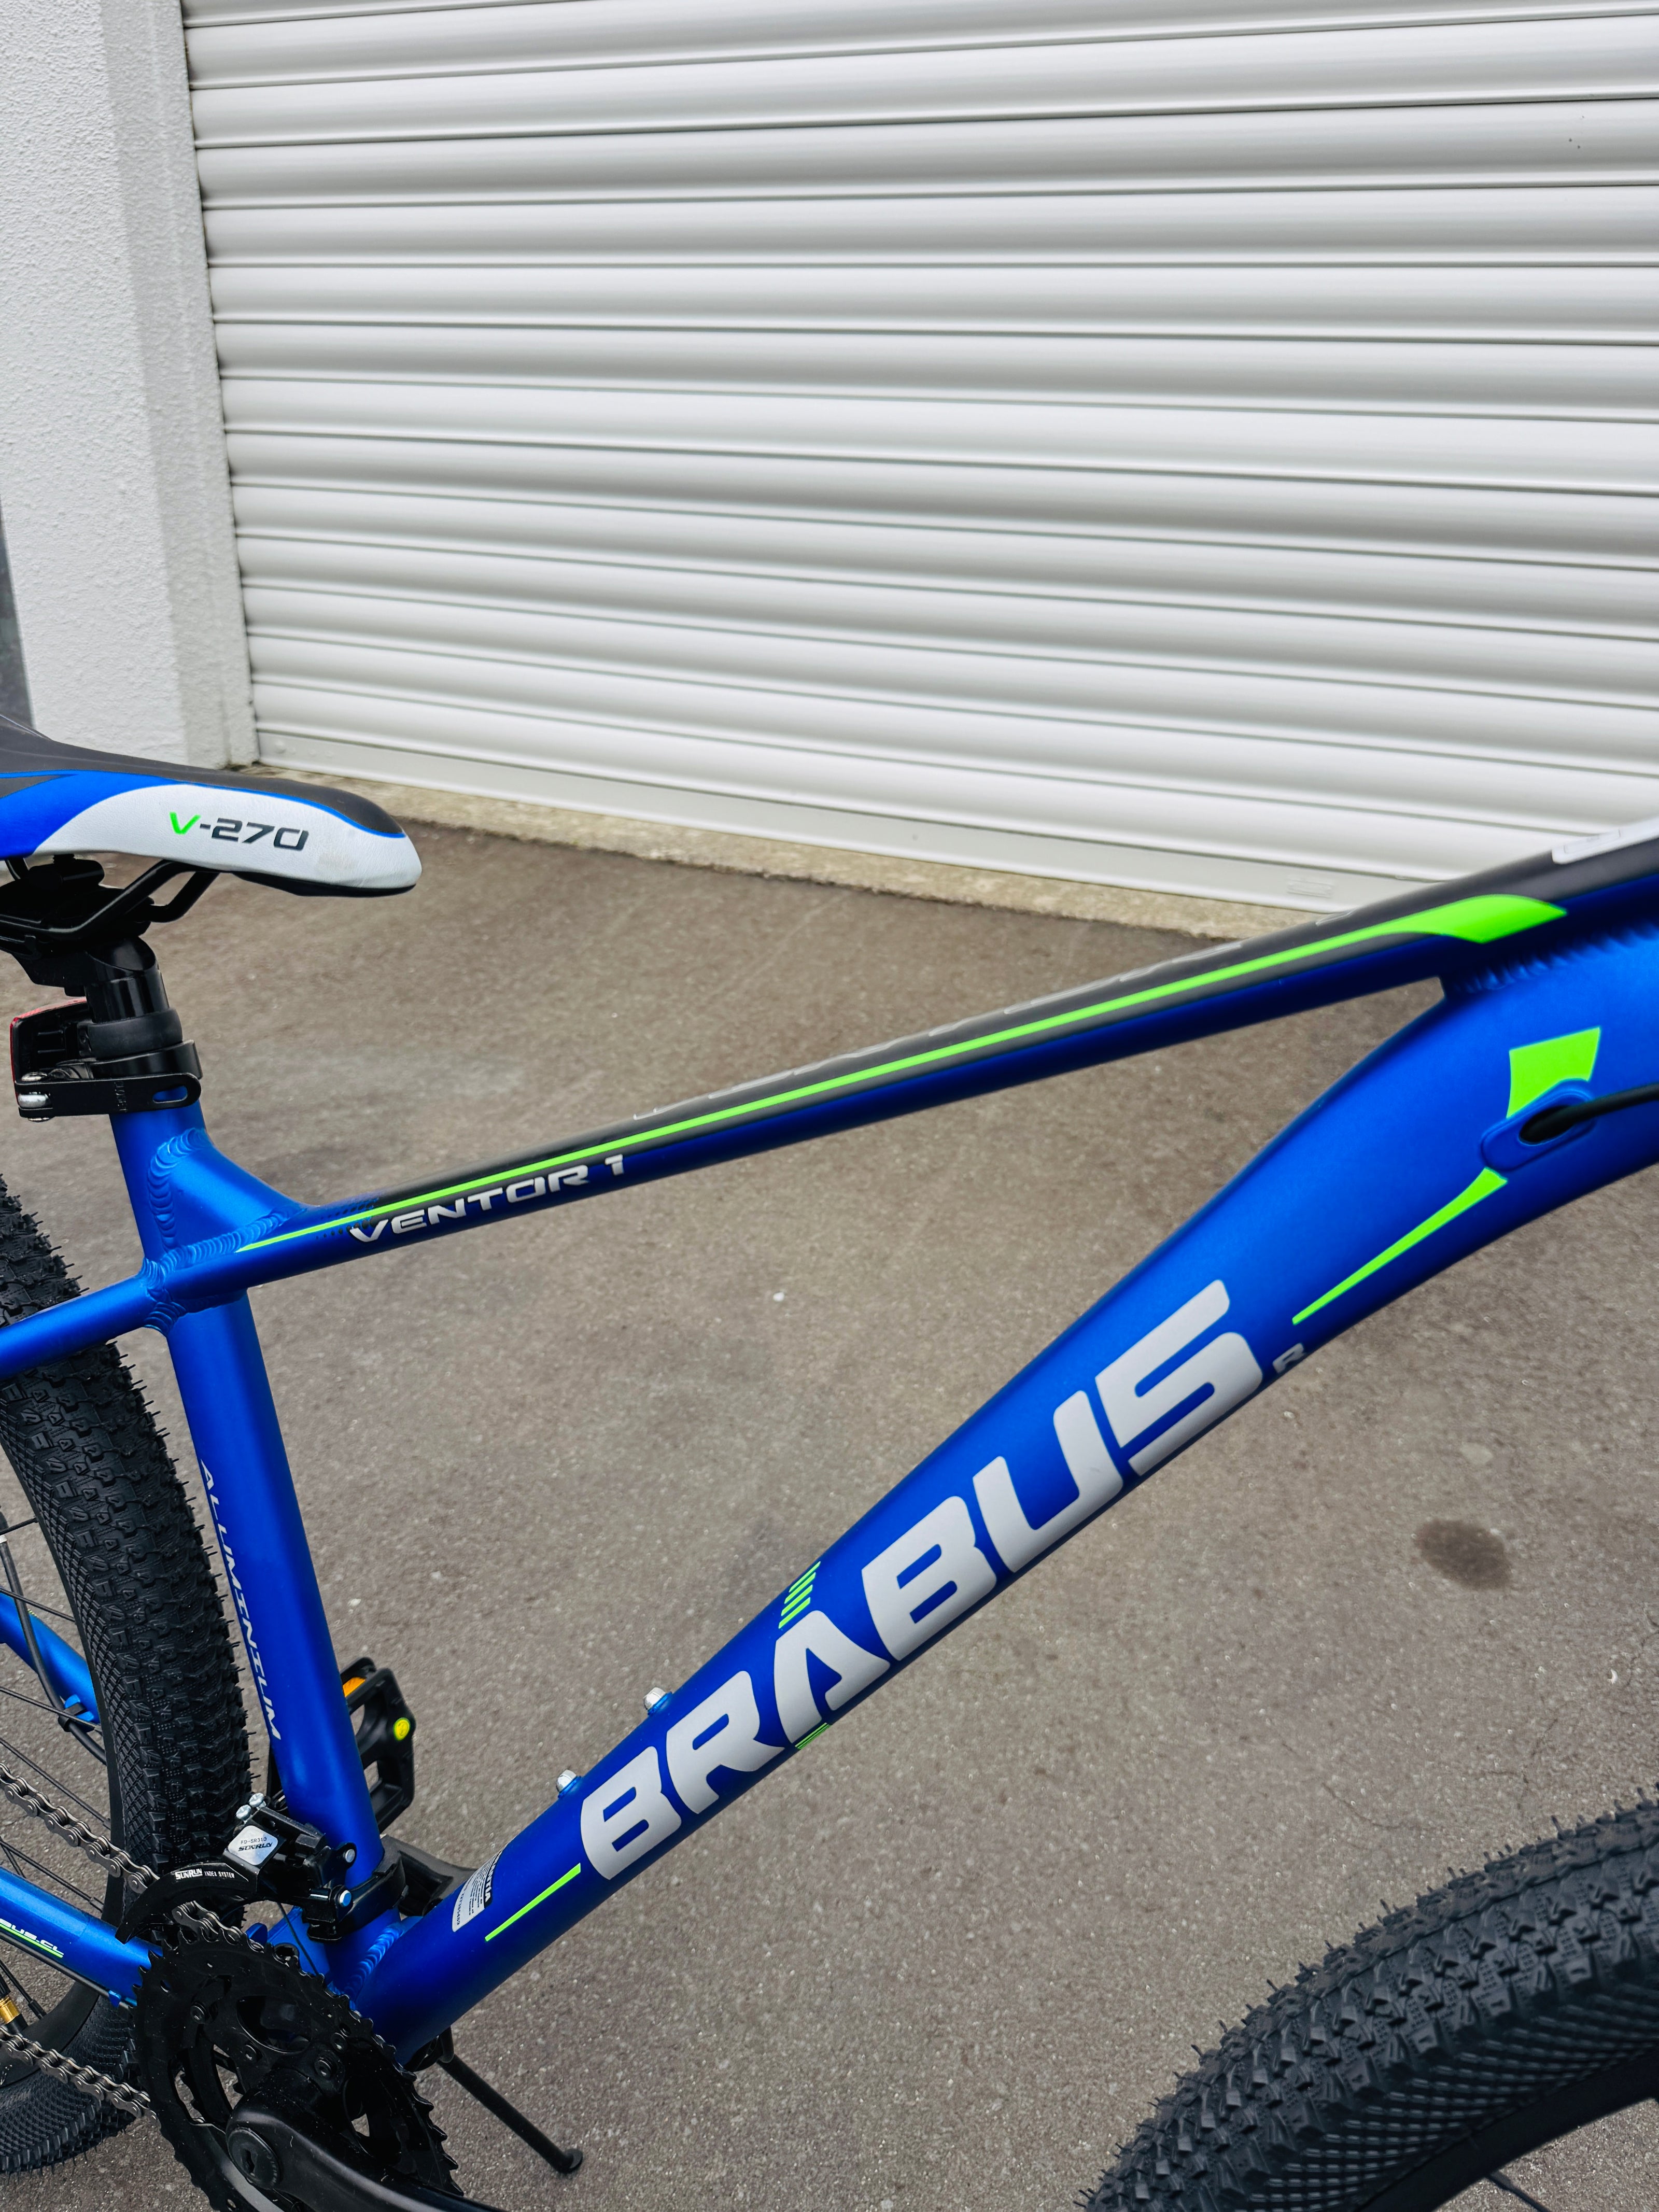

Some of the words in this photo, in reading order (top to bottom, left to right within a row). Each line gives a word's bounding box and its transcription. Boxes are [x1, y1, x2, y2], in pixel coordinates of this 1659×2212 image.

[170, 812, 309, 851] V-270
[350, 1165, 590, 1243] VENTOR
[605, 1154, 624, 1176] 1
[580, 1279, 1263, 1880] BRABUS
